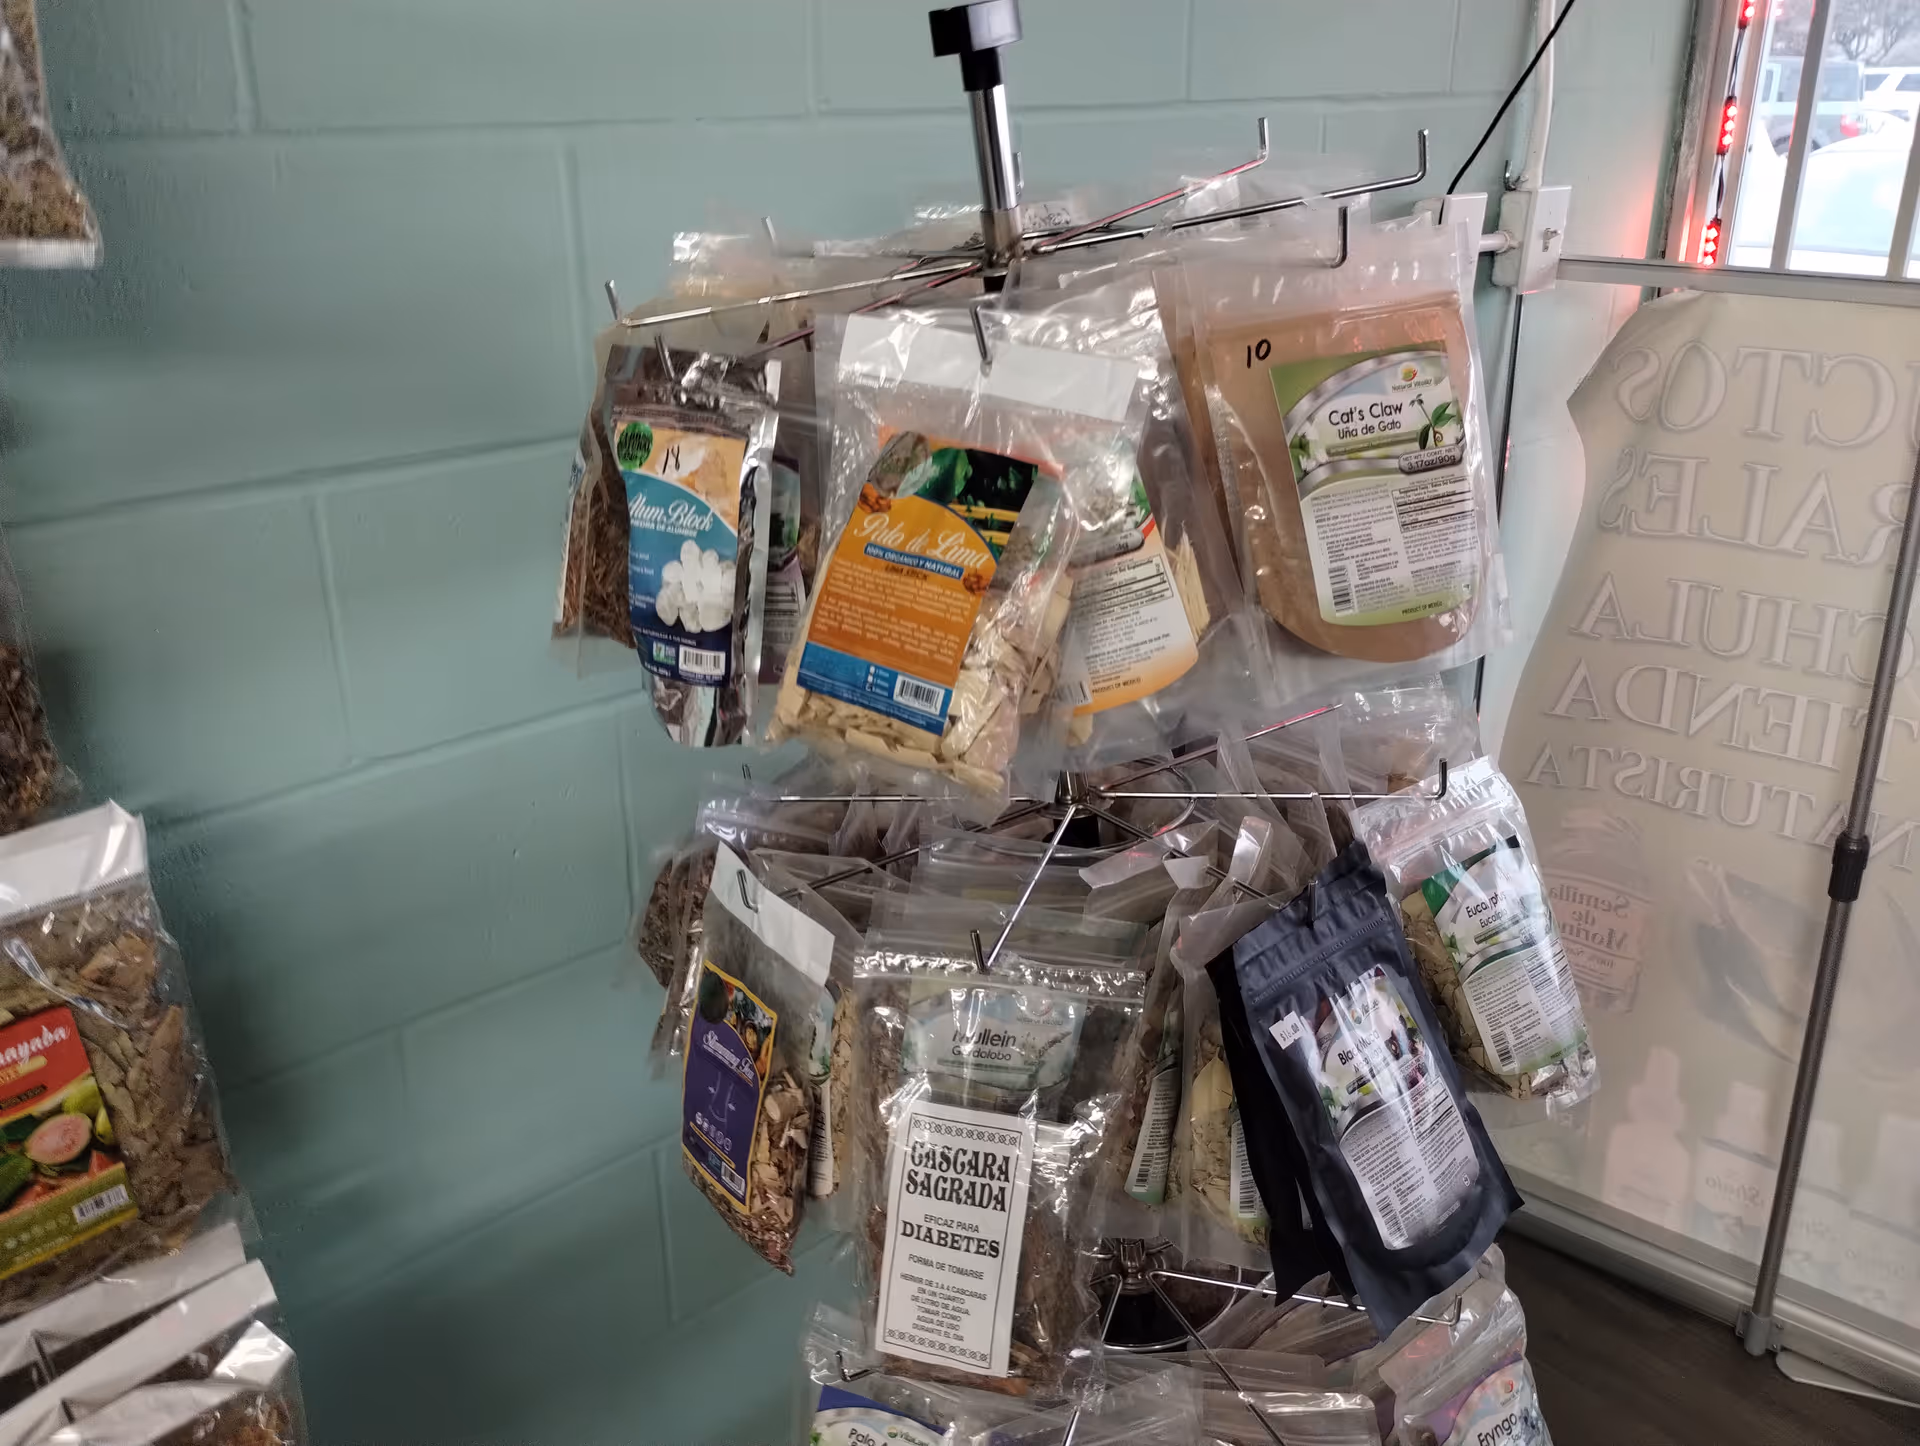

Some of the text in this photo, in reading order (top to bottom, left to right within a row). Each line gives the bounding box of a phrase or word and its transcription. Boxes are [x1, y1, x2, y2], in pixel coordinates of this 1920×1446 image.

[1246, 339, 1271, 368] 10
[1328, 402, 1403, 426] Cat's Claw
[1337, 420, 1401, 440] Uña de Gato
[668, 499, 714, 532] Block
[925, 561, 960, 578] NATURAL
[911, 1140, 1010, 1182] CASCARA
[906, 1168, 1007, 1212] SAGRADA
[924, 1214, 980, 1234] EFICAZ PARA
[900, 1220, 1000, 1258] DIABETES
[908, 1254, 984, 1280] FORMA DE TOMARSE
[917, 1286, 926, 1294] EN
[938, 1292, 966, 1304] CUARTO
[924, 1279, 934, 1287] DE
[951, 1286, 988, 1300] CASCARAS
[910, 1294, 920, 1302] DE
[920, 1297, 940, 1308] LITRO
[940, 1302, 950, 1310] DE
[916, 1304, 962, 1322] TOMAR COMO
[916, 1315, 960, 1331] AGUA DE USO
[848, 1428, 876, 1446] Palo
